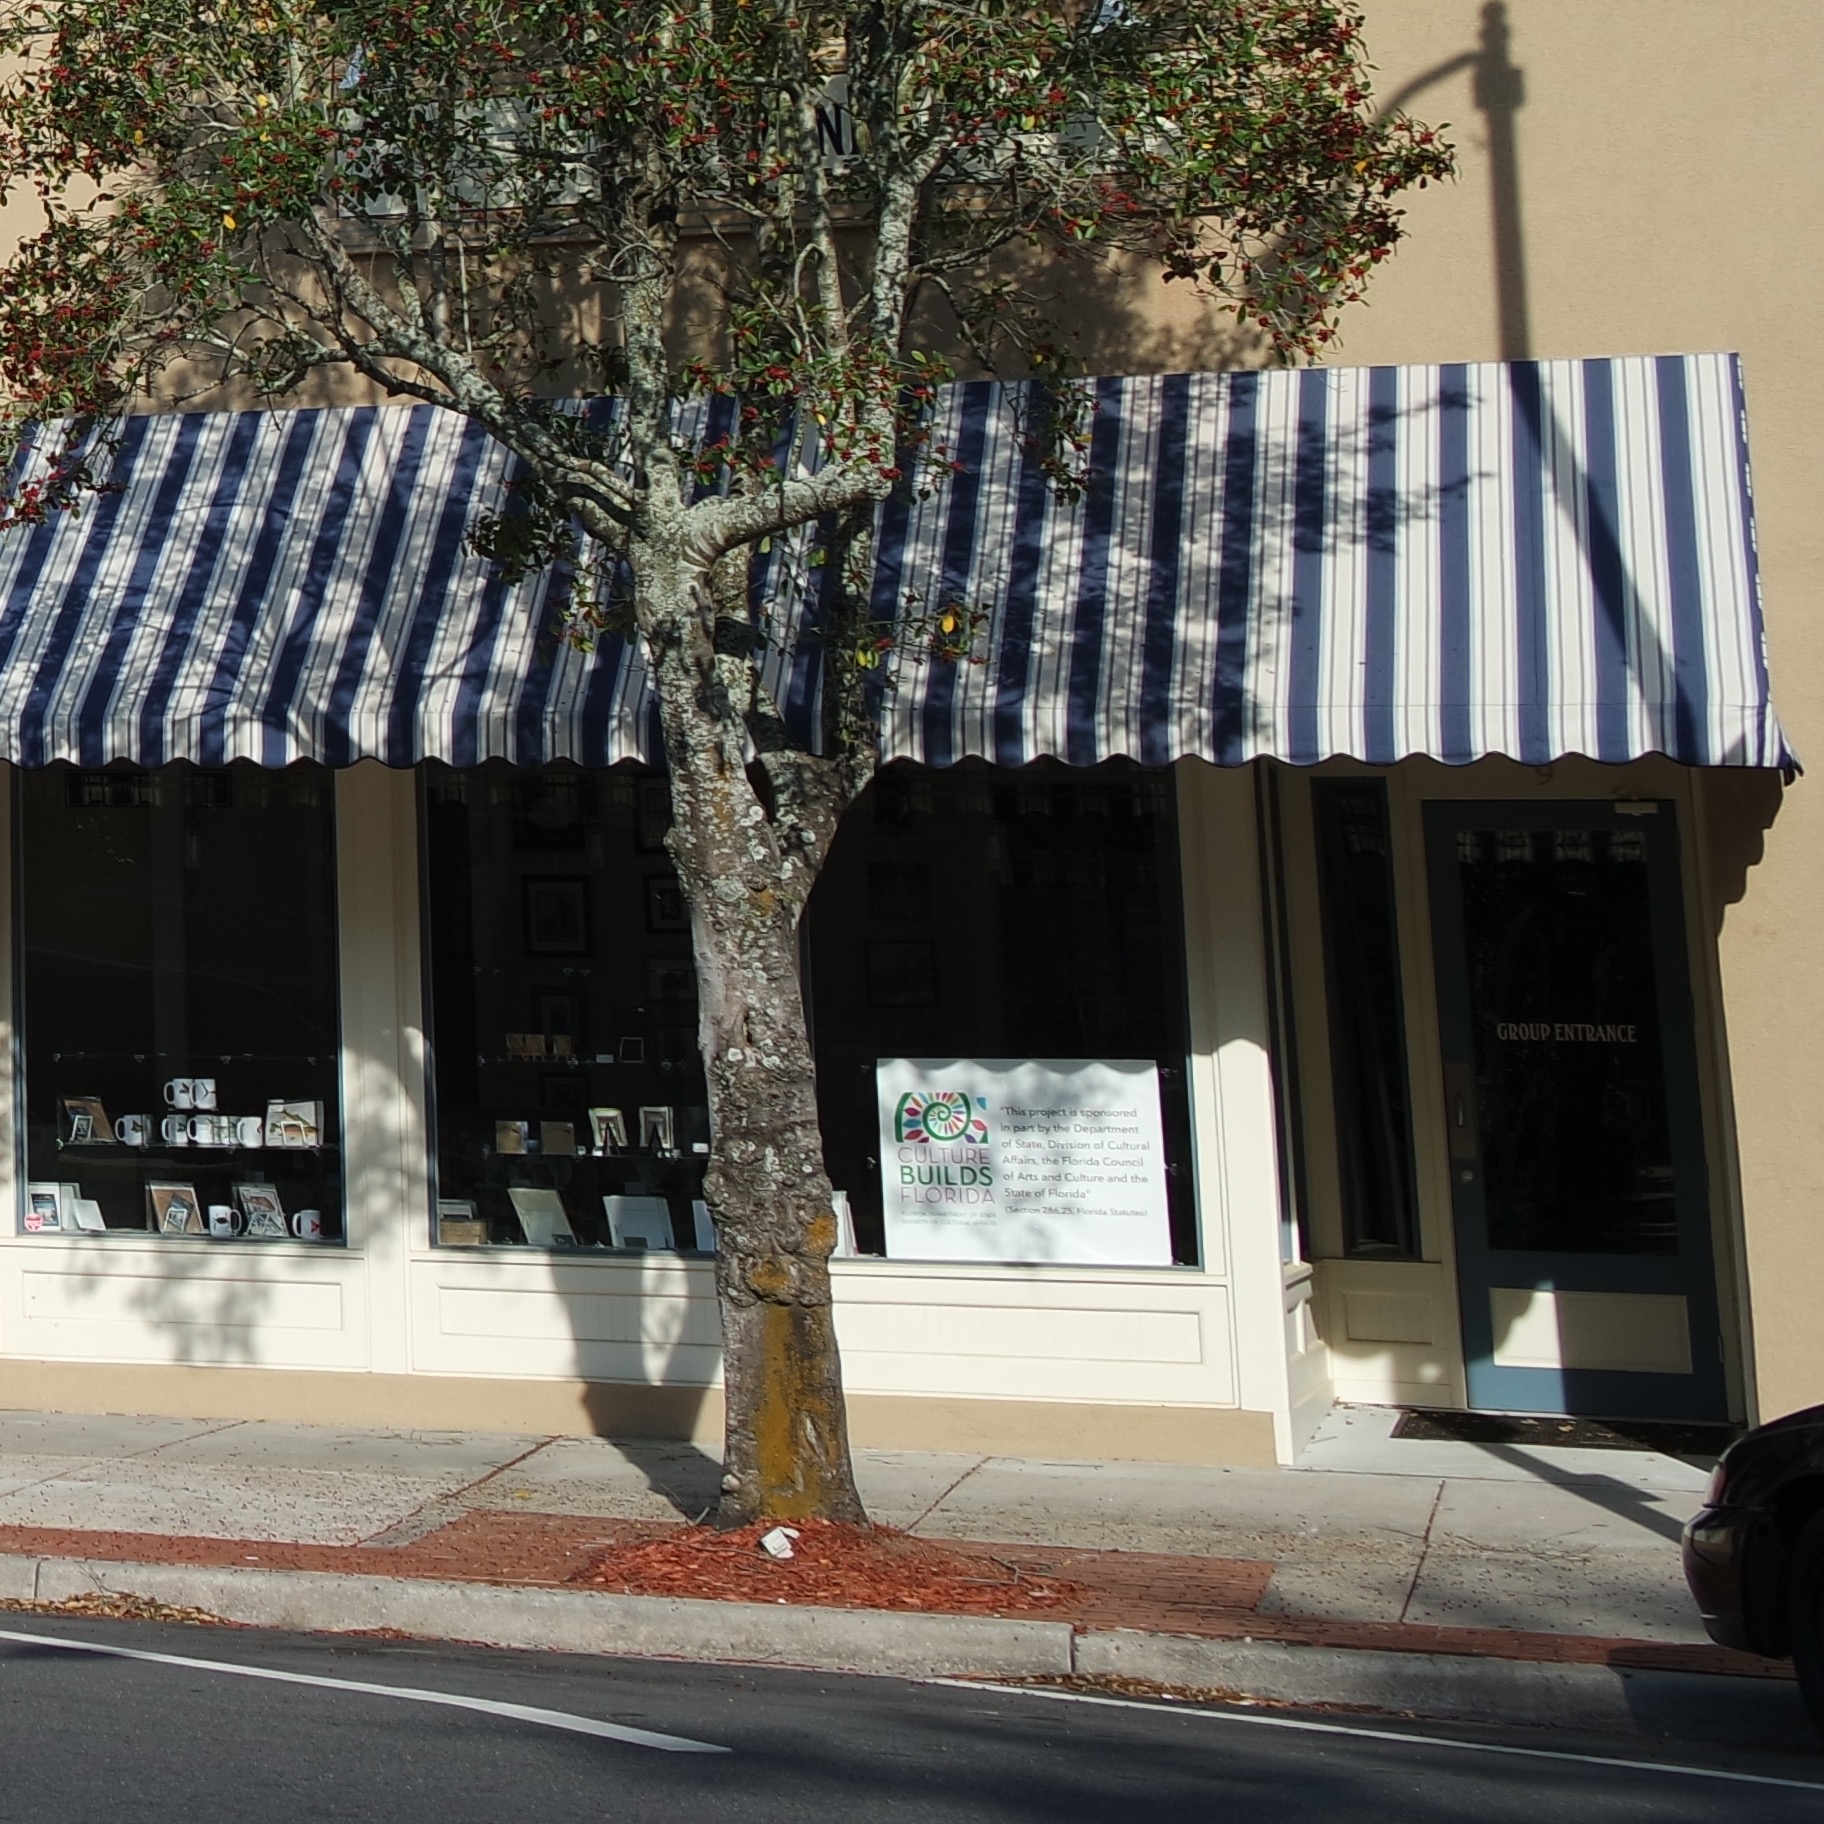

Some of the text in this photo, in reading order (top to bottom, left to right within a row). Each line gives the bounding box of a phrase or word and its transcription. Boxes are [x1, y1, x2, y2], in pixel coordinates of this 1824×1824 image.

[1496, 1022, 1638, 1043] GROUP ENTRANCE
[1029, 1108, 1067, 1119] project
[1069, 1108, 1078, 1116] is
[1080, 1108, 1138, 1119] sponsored
[1000, 1122, 1140, 1135] in part by the Department
[1001, 1139, 1013, 1149] of
[1048, 1140, 1091, 1150] Division
[1093, 1140, 1104, 1150] of
[1107, 1141, 1150, 1151] Cultural
[897, 1147, 991, 1165] CULTURE
[1041, 1156, 1060, 1165] the
[1061, 1156, 1100, 1166] Florida
[1102, 1157, 1144, 1167] Council
[900, 1165, 994, 1187] BUILDS
[1017, 1172, 1039, 1181] Arts
[1041, 1172, 1062, 1182] and
[1064, 1173, 1105, 1182] Culture
[1106, 1174, 1128, 1183] and
[1130, 1174, 1149, 1183] the
[900, 1187, 995, 1204] FLORIDA
[1004, 1187, 1032, 1197] State
[1034, 1188, 1045, 1197] of
[1077, 1207, 1108, 1216] Florida
